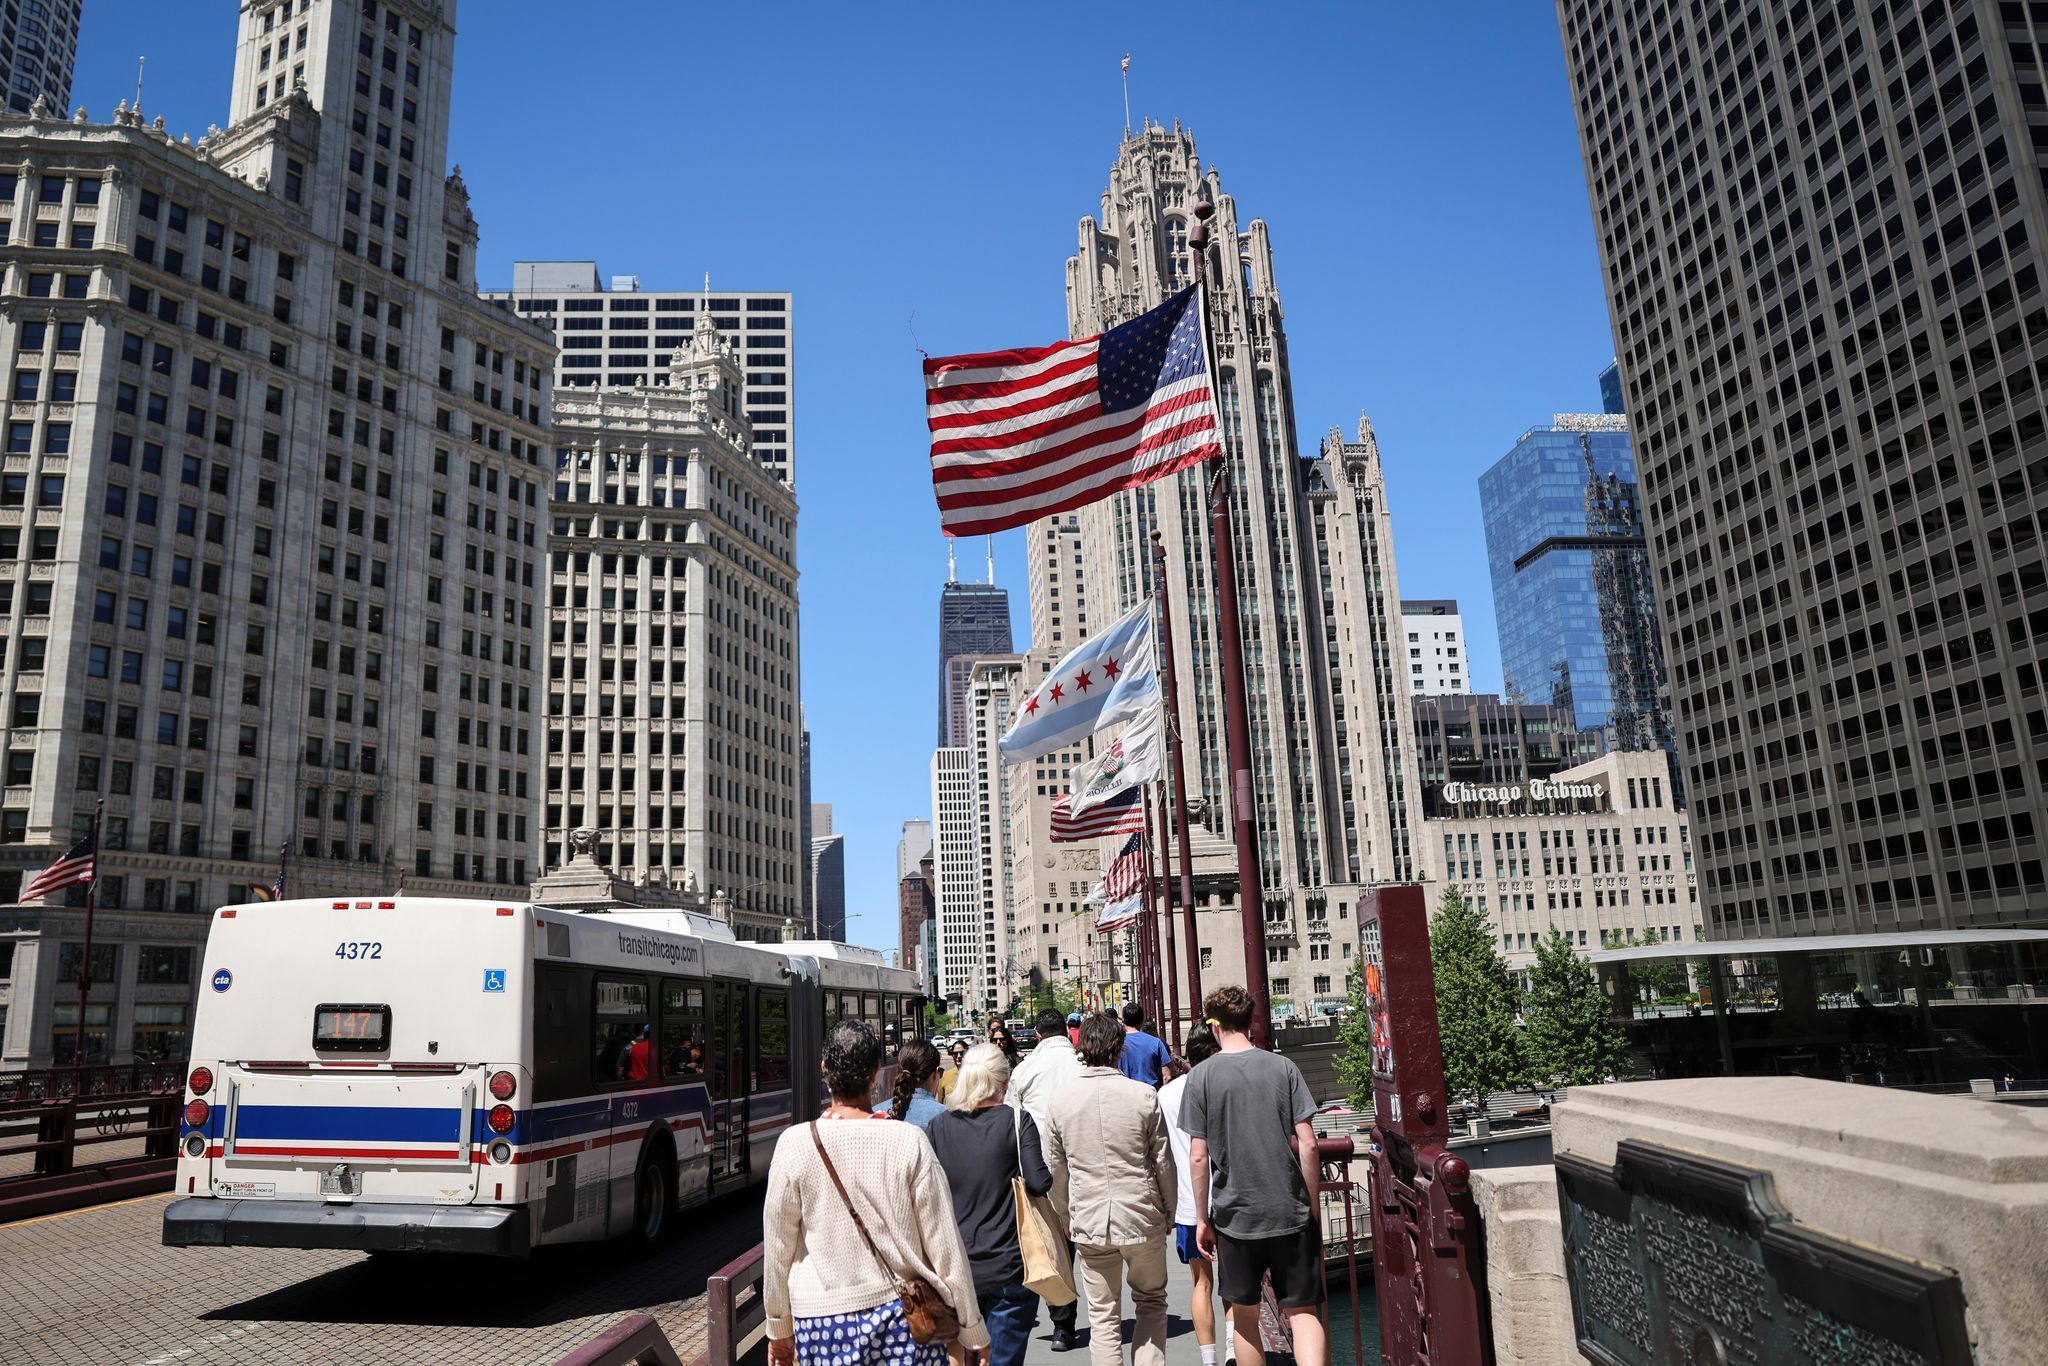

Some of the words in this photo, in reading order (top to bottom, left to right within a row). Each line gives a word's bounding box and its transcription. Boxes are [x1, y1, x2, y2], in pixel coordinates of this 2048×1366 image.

[1442, 781, 1521, 805] Chicago
[1529, 778, 1604, 801] Tribune
[335, 942, 382, 960] 4372
[618, 932, 698, 965] transitchicago.com
[214, 976, 230, 985] cta
[331, 1012, 371, 1038] 147
[622, 1102, 638, 1119] 4372
